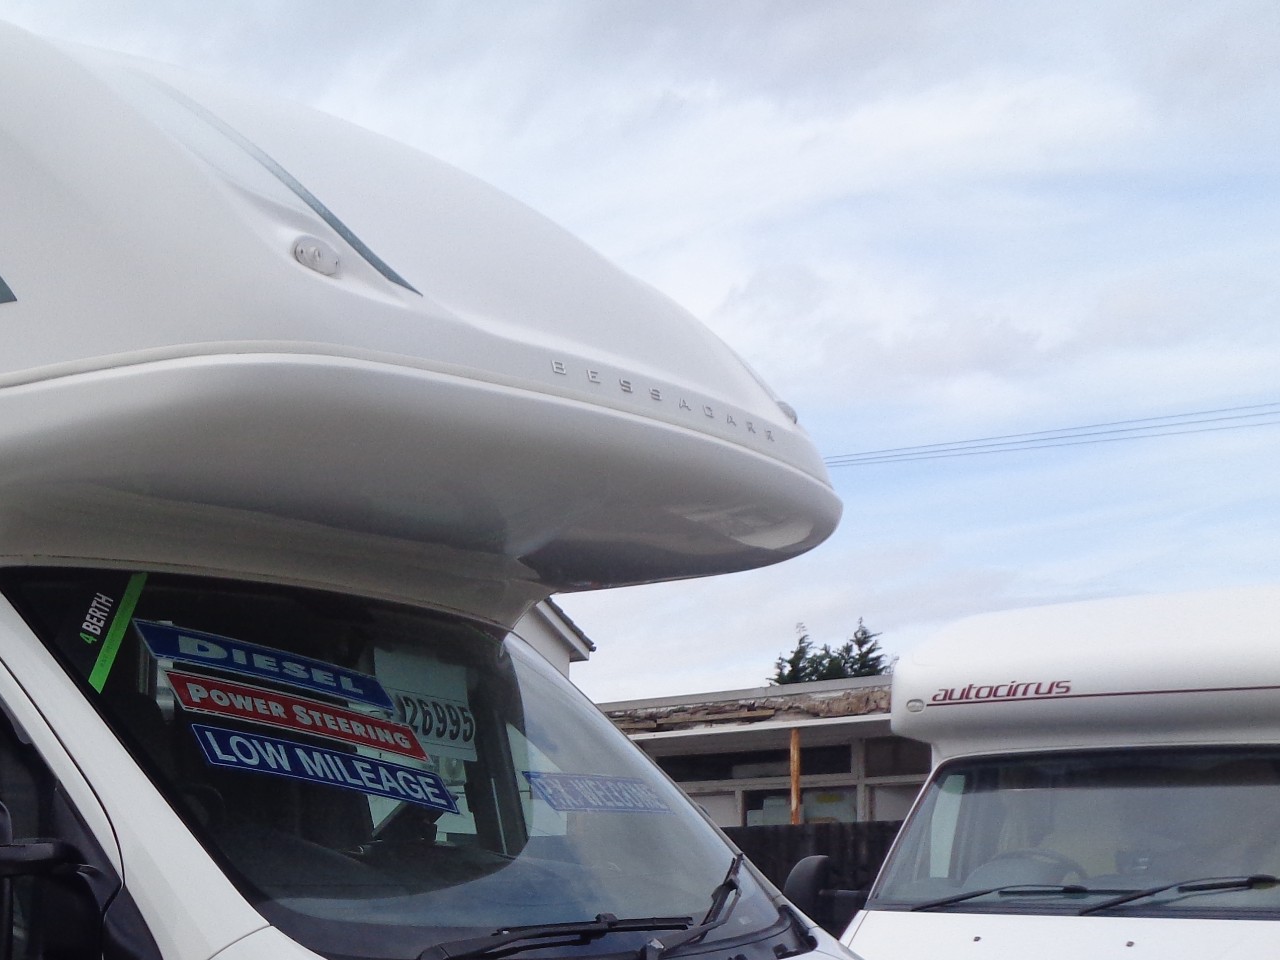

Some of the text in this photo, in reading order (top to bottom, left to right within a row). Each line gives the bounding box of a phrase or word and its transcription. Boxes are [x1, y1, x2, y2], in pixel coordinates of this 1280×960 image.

[79, 592, 114, 645] 4 BERTH
[178, 635, 366, 695] DIESEL
[931, 680, 1072, 702] autocirrus
[186, 682, 411, 748] POWER STEERING
[204, 730, 448, 805] LOW MILEAGE
